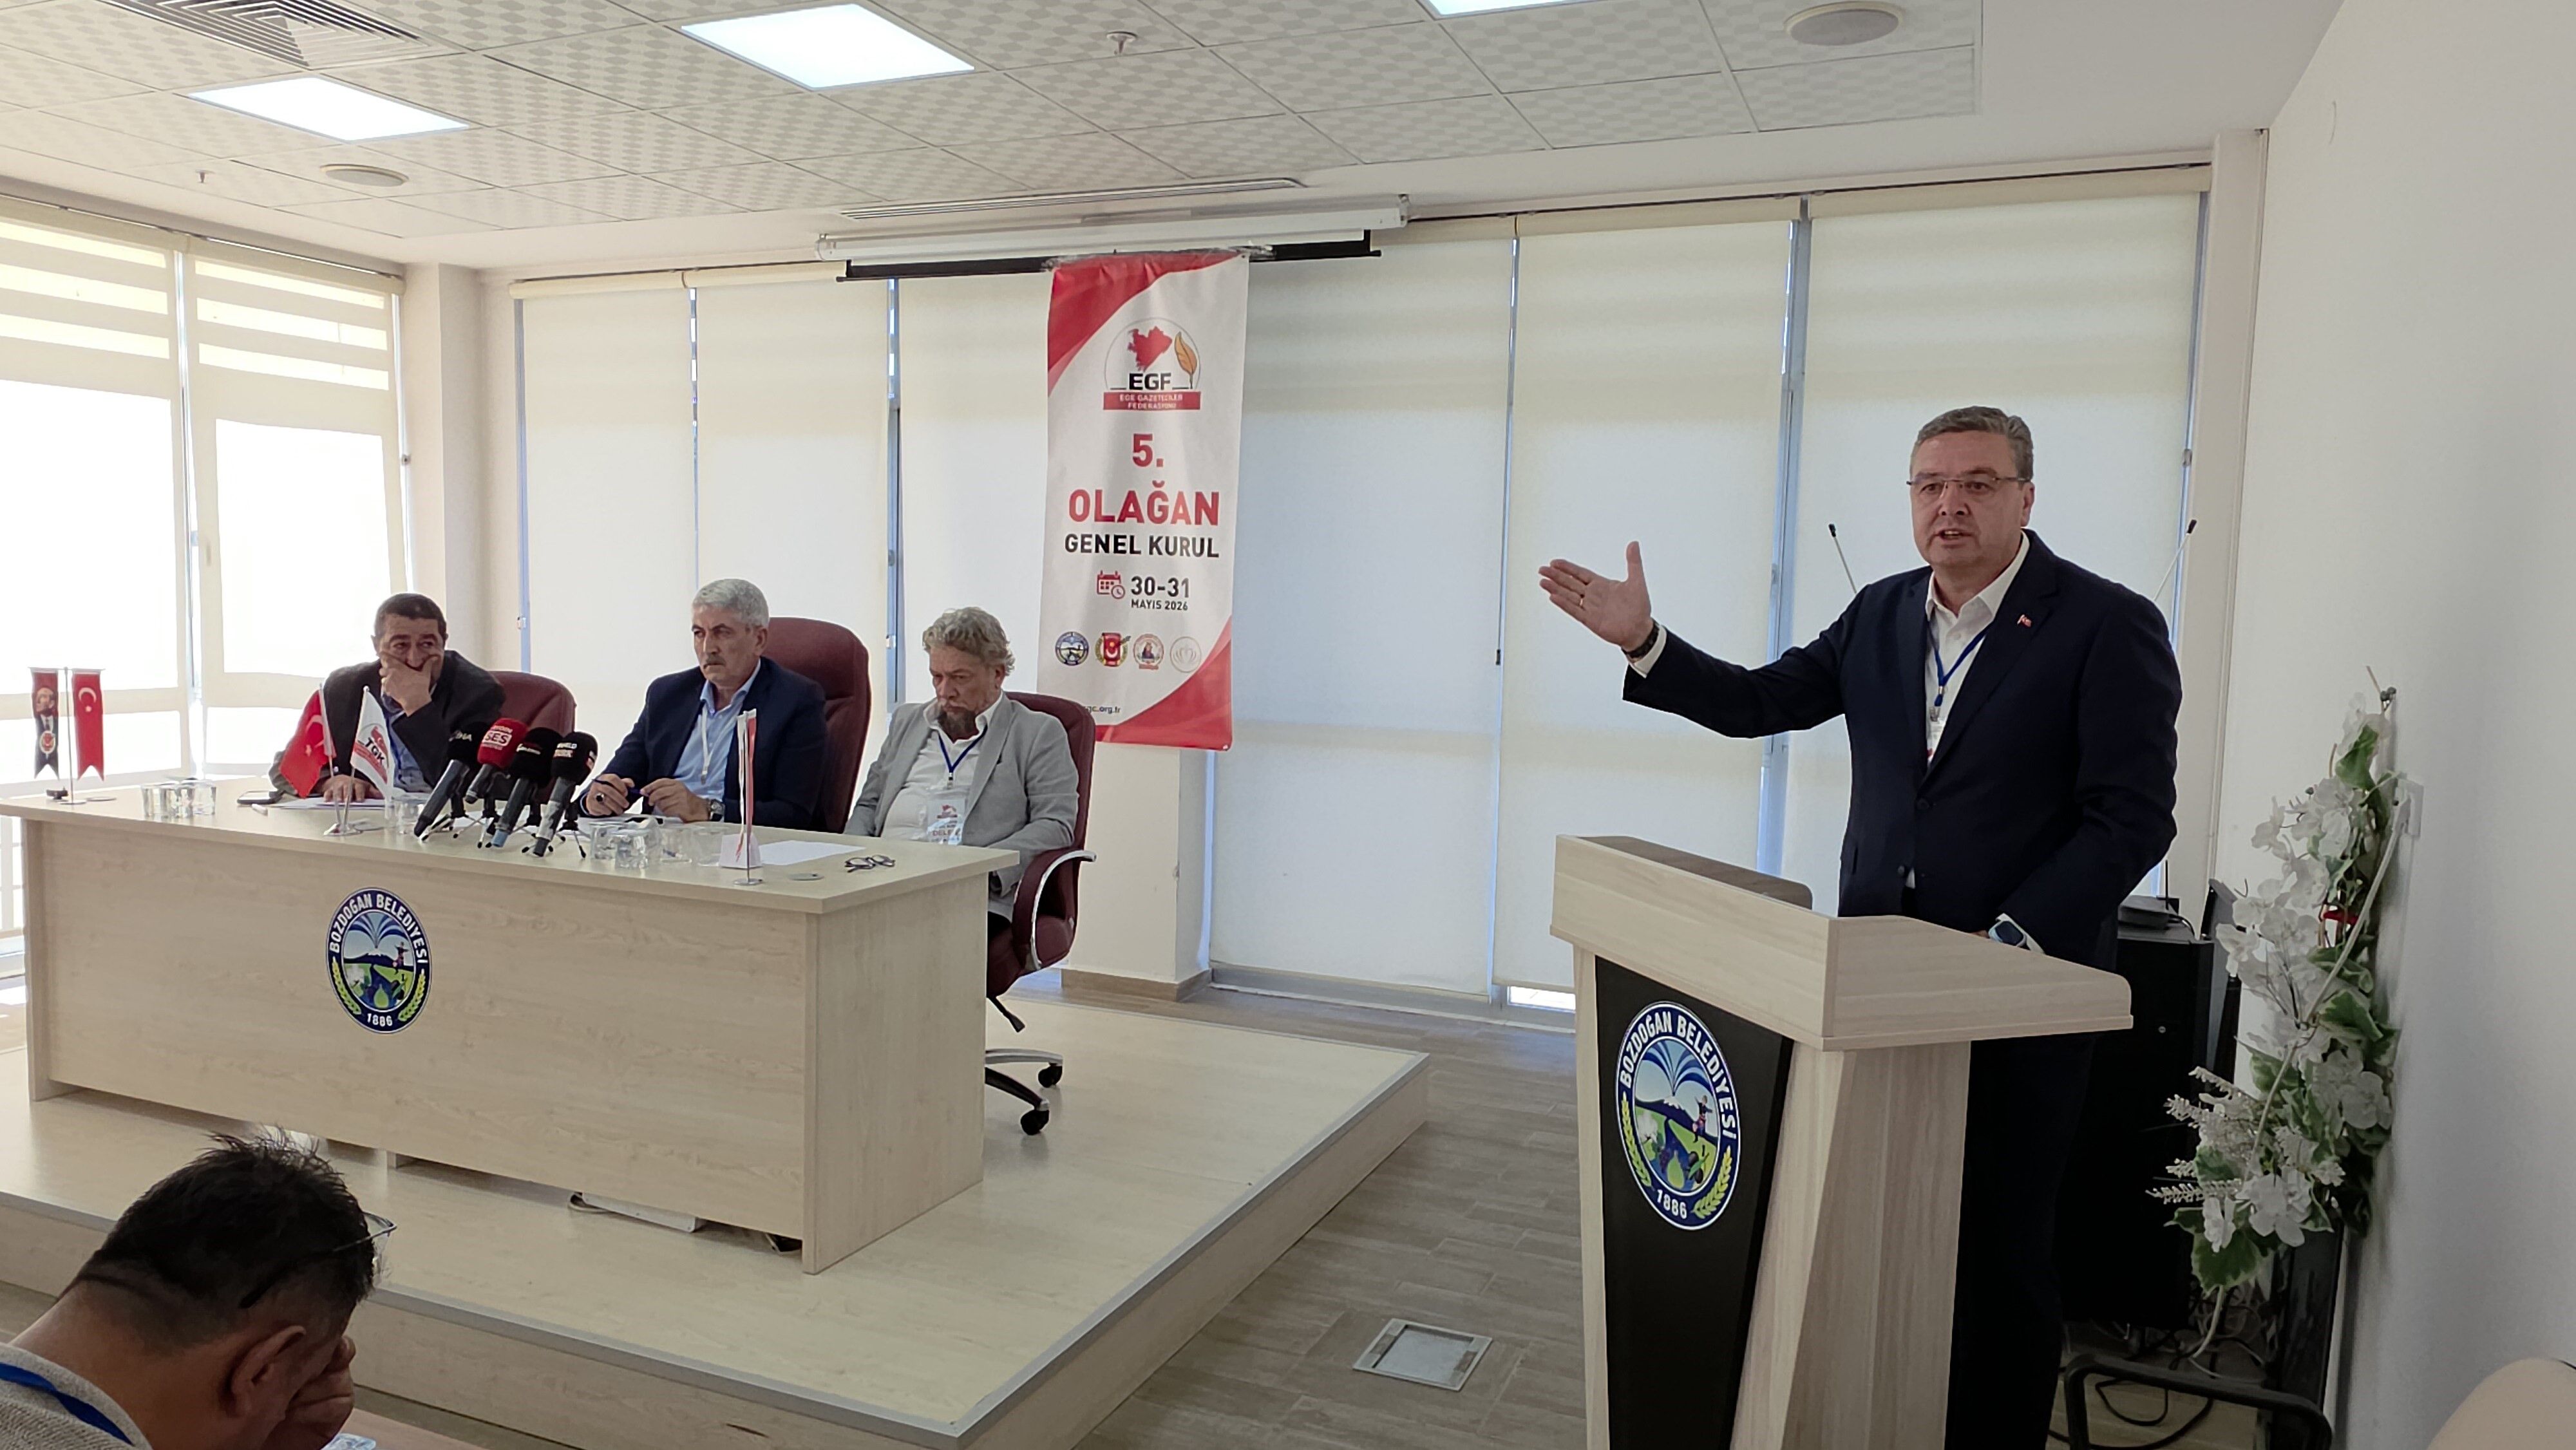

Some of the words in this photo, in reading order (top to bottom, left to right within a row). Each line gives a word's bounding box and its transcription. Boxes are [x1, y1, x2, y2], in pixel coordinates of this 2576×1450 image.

[1129, 373, 1171, 390] EGF
[1133, 433, 1164, 467] 5.
[1069, 480, 1219, 526] OLAĞAN
[1065, 534, 1141, 555] GENEL
[1149, 535, 1219, 558] KURUL
[1131, 576, 1189, 598] 30-31
[1131, 599, 1162, 610] MAYIS
[1164, 601, 1188, 611] 2026
[485, 732, 507, 744] SES
[365, 737, 384, 766] TGK
[367, 1013, 393, 1027] 1886
[1657, 1189, 1687, 1219] 1886
